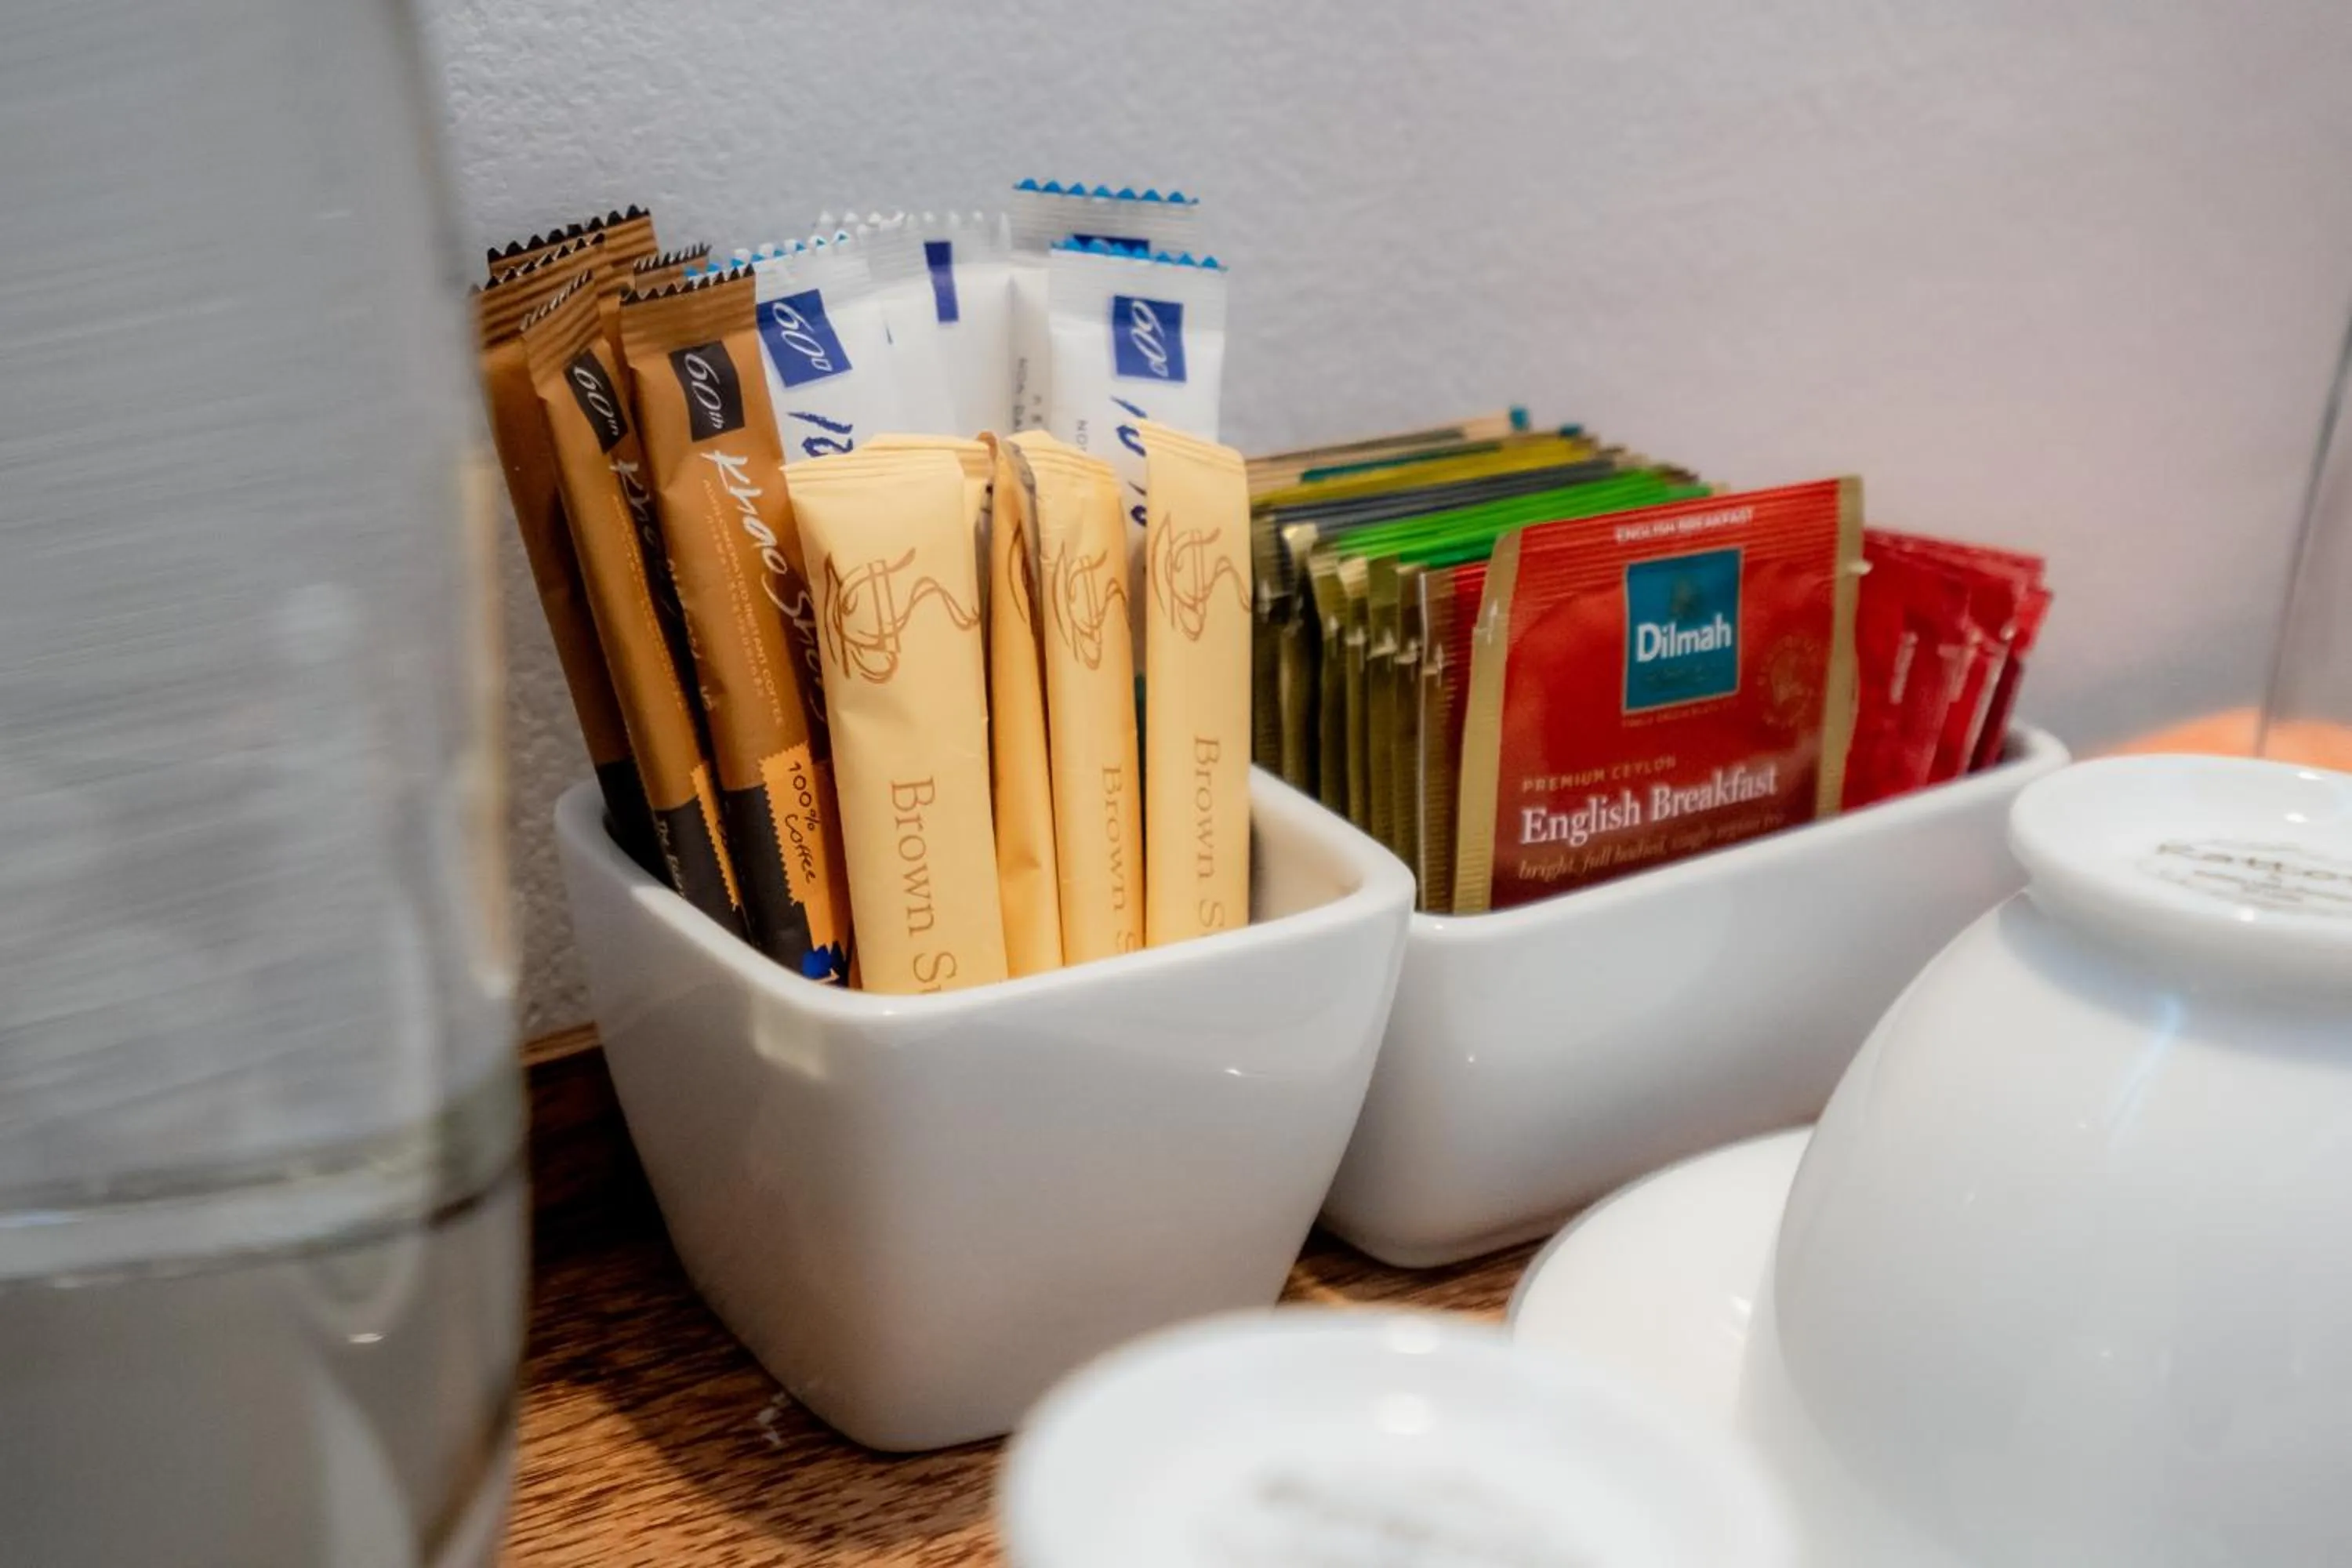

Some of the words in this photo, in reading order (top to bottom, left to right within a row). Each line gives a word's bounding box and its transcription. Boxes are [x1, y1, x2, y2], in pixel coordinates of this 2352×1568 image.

[700, 450, 787, 575] Khao
[1636, 613, 1732, 662] Dilmah
[760, 668, 785, 728] COFFEE
[789, 761, 822, 831] 100%
[1195, 735, 1221, 880] Brown
[1519, 789, 1641, 848] English
[1650, 764, 1777, 822] Breakfast
[1522, 768, 1606, 792] PREMIUM
[1611, 756, 1676, 779] CEYLON
[785, 814, 815, 885] Coffee
[891, 775, 936, 937] Brown
[1102, 764, 1125, 912] Brown
